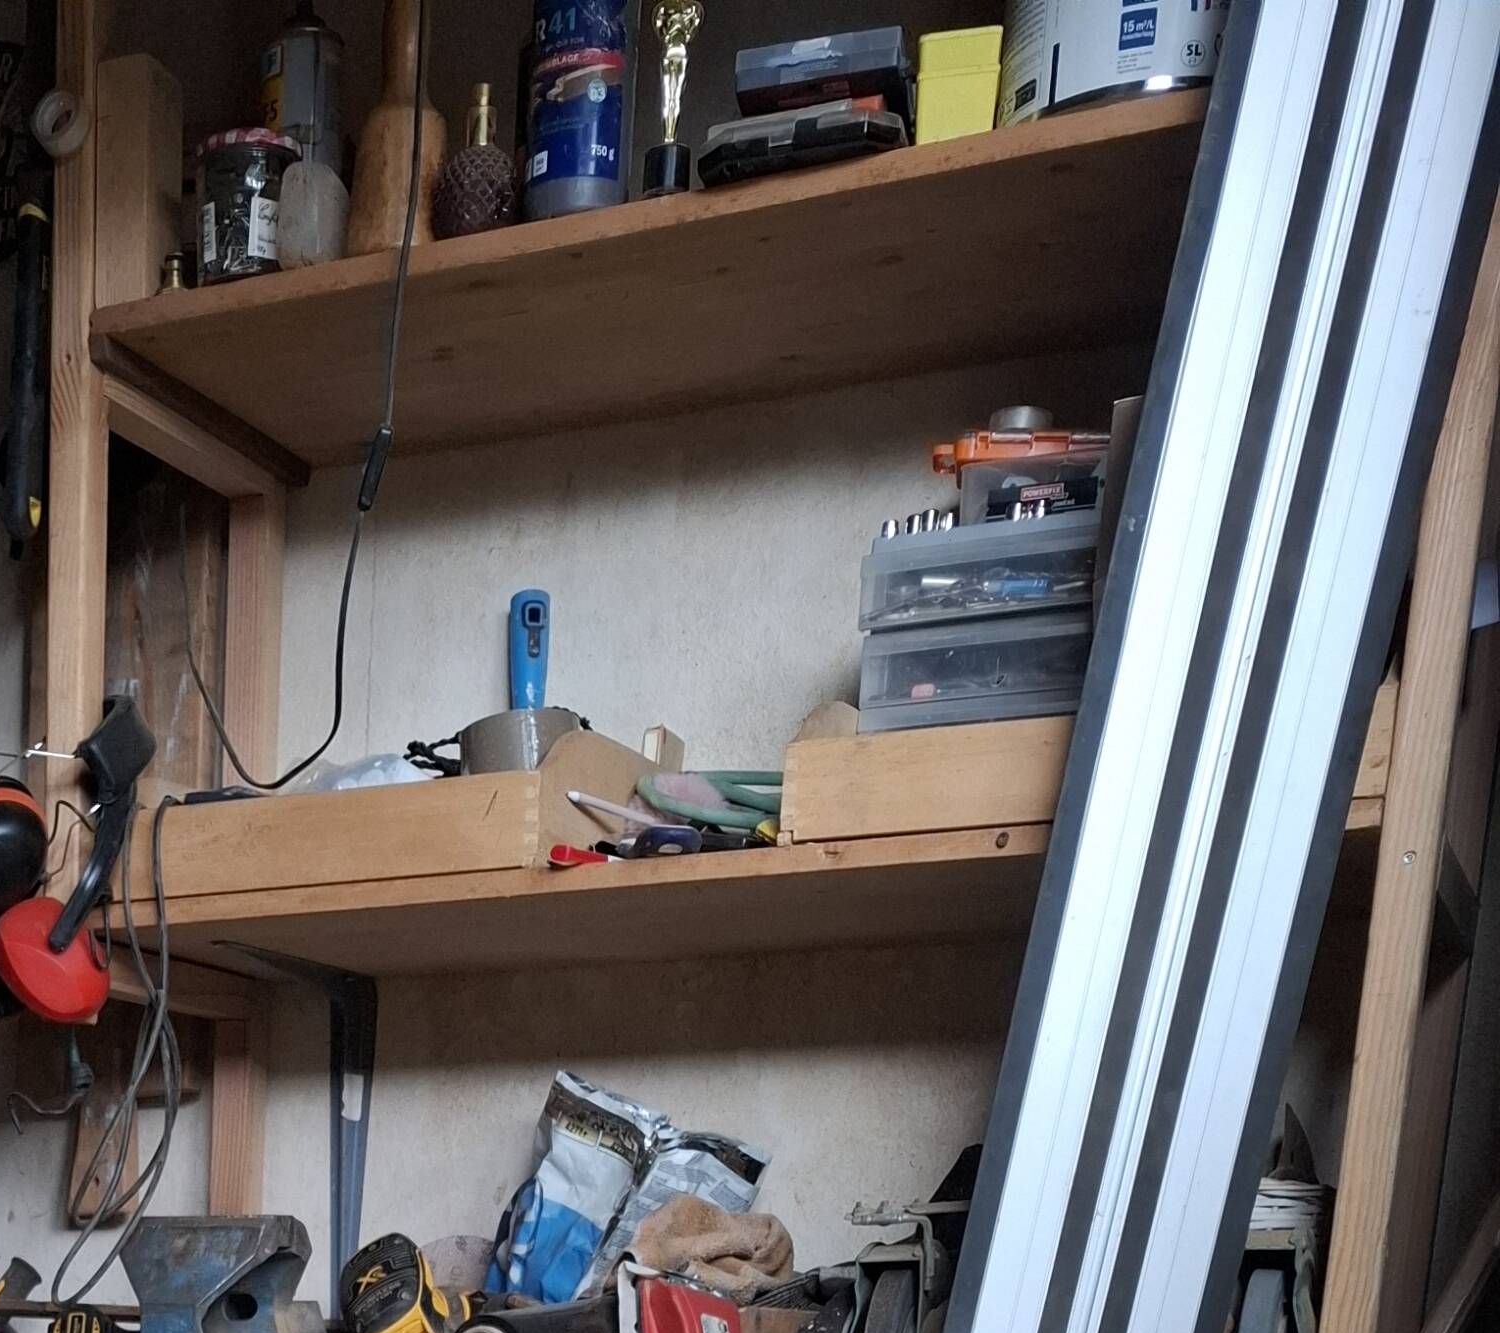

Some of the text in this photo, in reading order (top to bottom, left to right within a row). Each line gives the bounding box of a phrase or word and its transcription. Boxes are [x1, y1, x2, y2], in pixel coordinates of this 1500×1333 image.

[548, 6, 576, 35] 41
[1123, 20, 1135, 33] 15
[591, 144, 608, 157] 750
